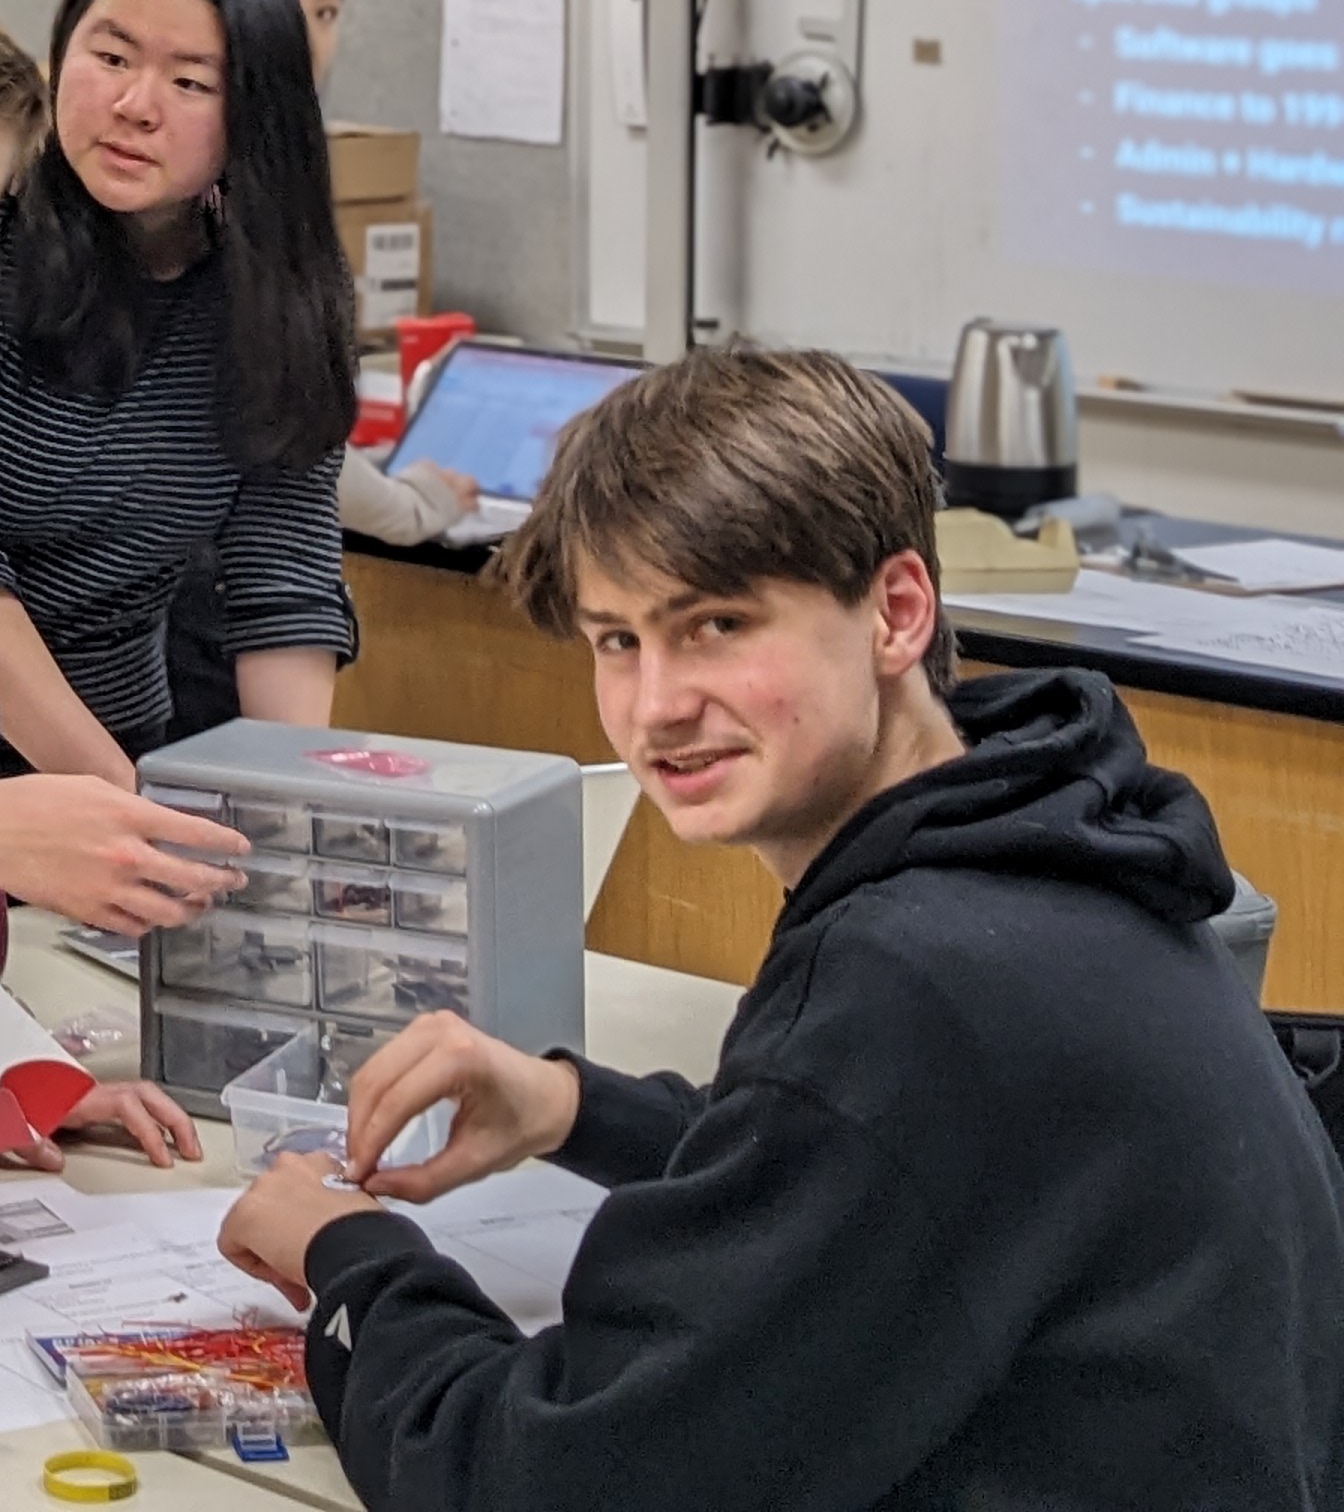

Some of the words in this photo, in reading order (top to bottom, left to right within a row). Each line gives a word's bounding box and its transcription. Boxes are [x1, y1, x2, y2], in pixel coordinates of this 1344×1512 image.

[1116, 24, 1251, 65] Software
[1115, 79, 1235, 120] Finance
[1241, 90, 1276, 126] to
[1116, 137, 1215, 176] Admin
[1117, 191, 1322, 250] Sustainability
